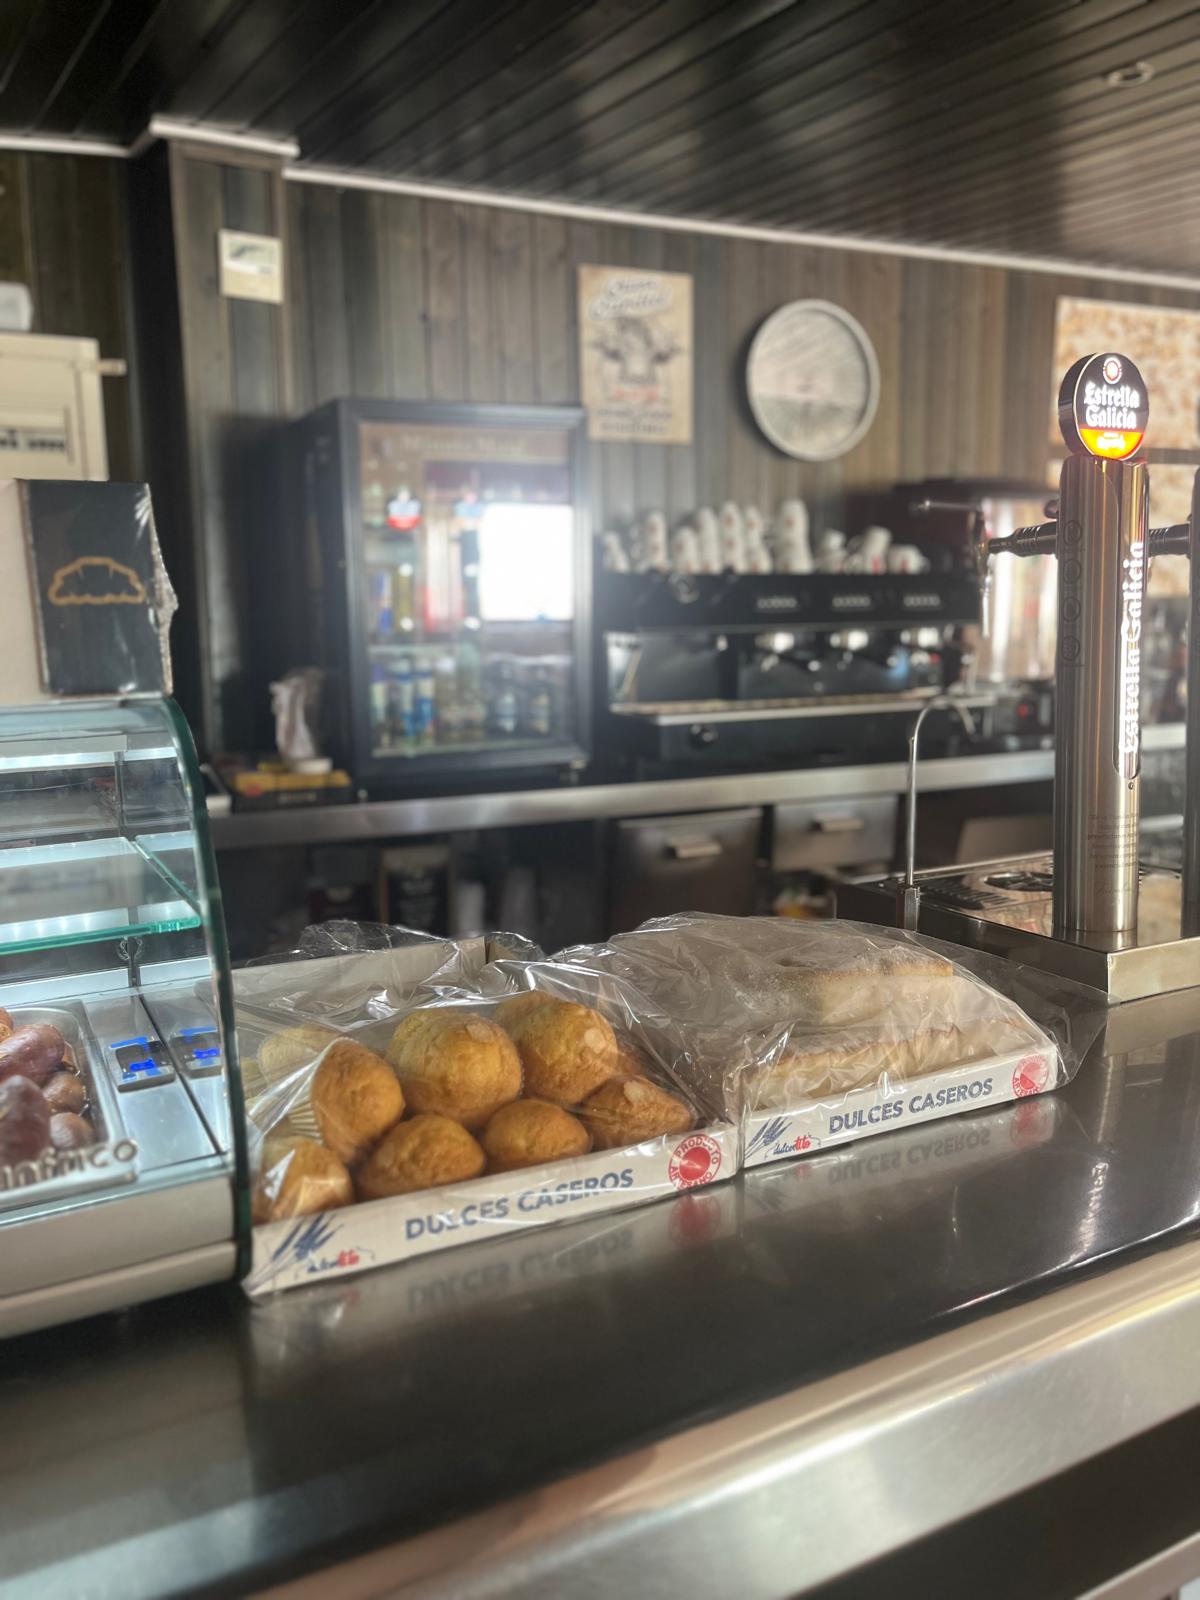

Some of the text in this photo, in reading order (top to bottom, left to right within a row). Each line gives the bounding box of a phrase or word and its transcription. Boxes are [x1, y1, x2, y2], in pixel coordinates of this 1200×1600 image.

[1083, 381, 1140, 409] Estrella
[1085, 404, 1137, 429] Galicia
[1121, 541, 1144, 643] Galicia
[829, 1100, 904, 1134] DULCES
[909, 1078, 993, 1114] CASEROS
[405, 1168, 634, 1240] DULCES CASEROS
